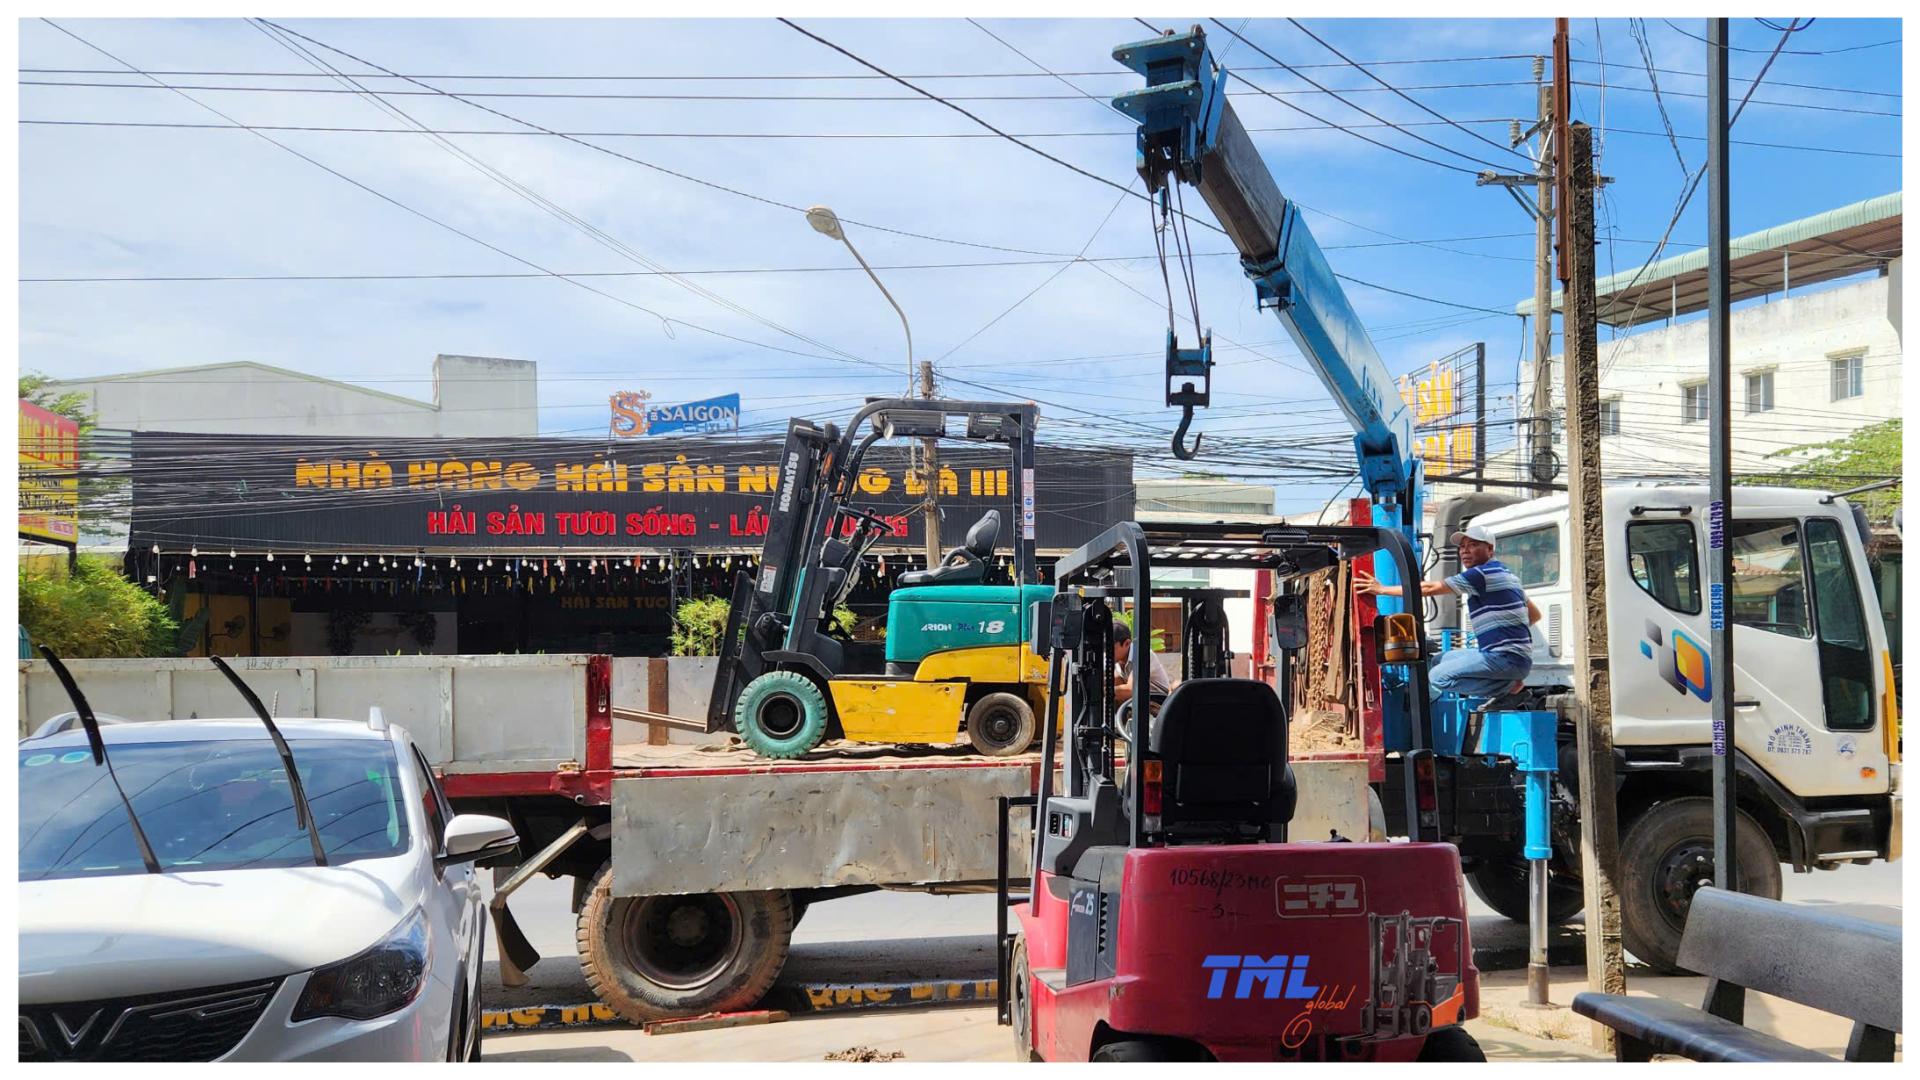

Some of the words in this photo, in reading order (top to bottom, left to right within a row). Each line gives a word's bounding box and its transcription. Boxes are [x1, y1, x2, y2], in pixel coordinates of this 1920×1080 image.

[661, 405, 738, 422] SAIGON
[642, 455, 726, 493] SẢN
[778, 451, 800, 513] KOMATSU
[427, 504, 476, 535] HẢI
[486, 504, 545, 536] SẢN
[555, 507, 617, 537] TƯƠI
[625, 504, 697, 537] SỐNG
[978, 620, 1005, 634] 18
